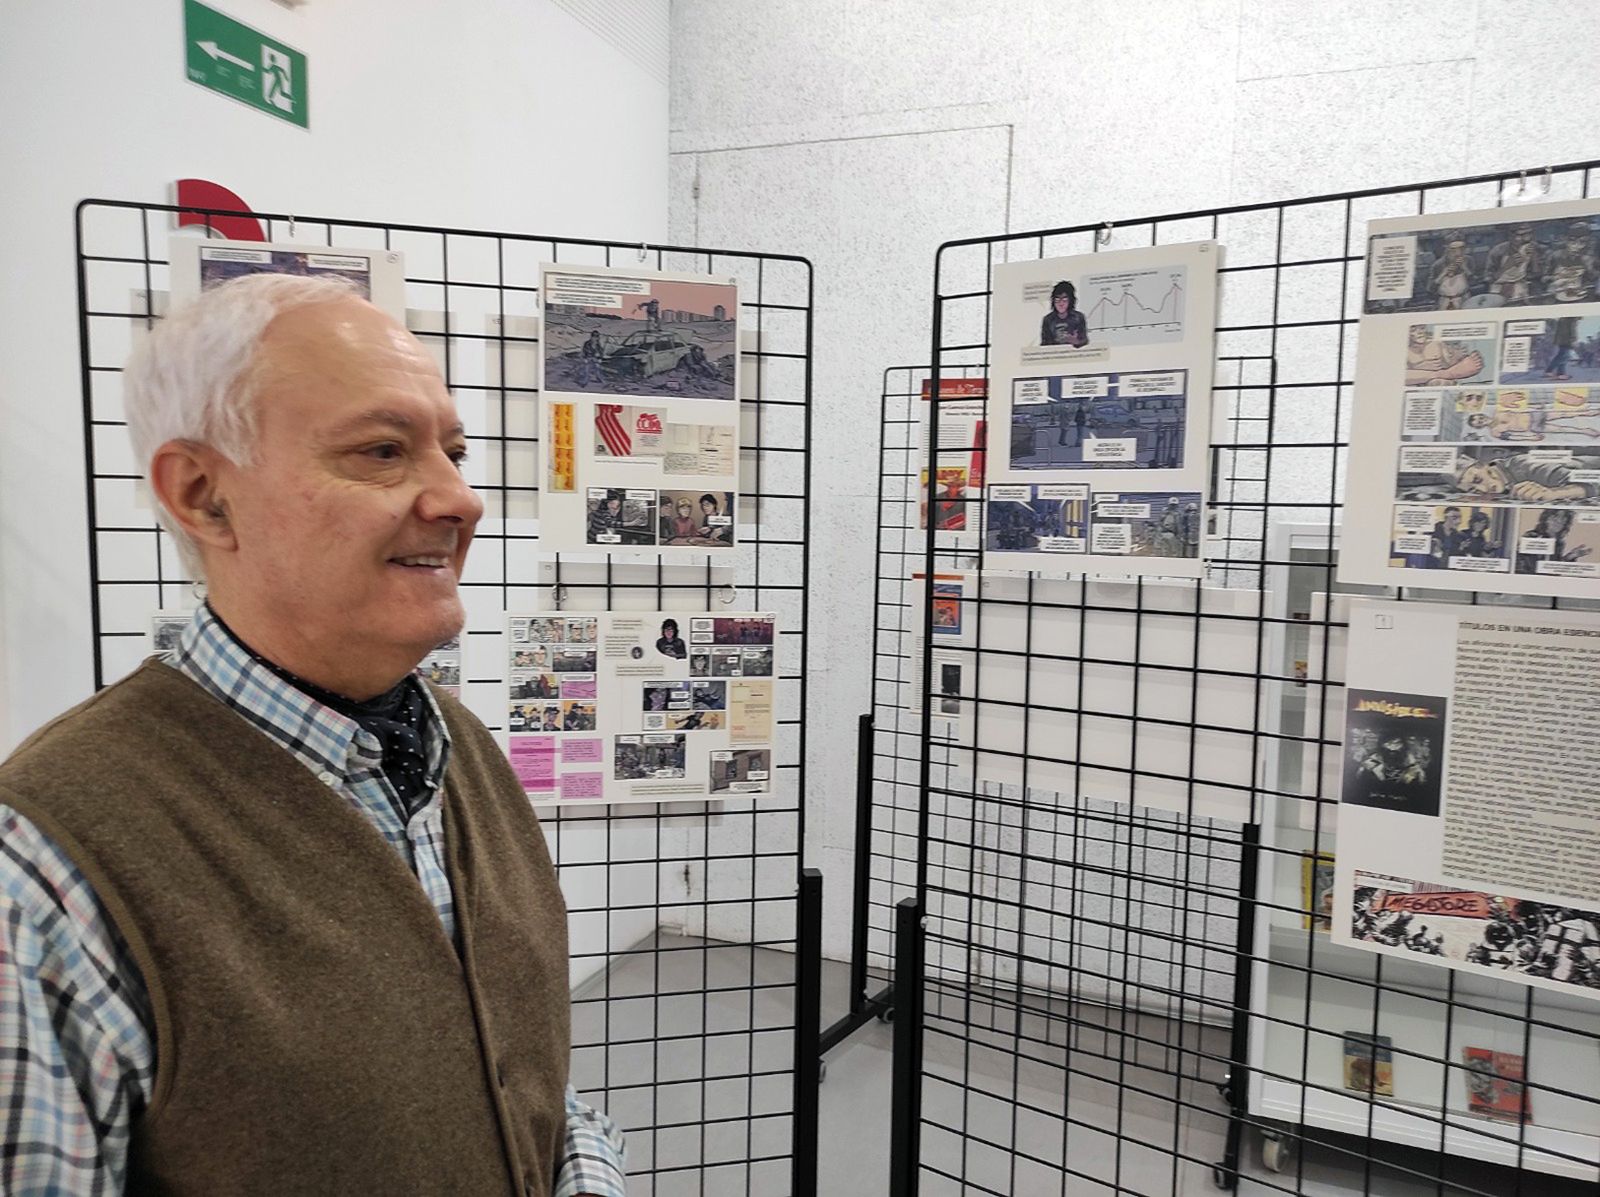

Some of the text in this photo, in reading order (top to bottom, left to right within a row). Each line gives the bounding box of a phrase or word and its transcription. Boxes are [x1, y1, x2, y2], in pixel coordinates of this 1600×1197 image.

[1497, 624, 1511, 632] EN
[1513, 626, 1532, 634] UNA
[1535, 627, 1561, 636] OBRA
